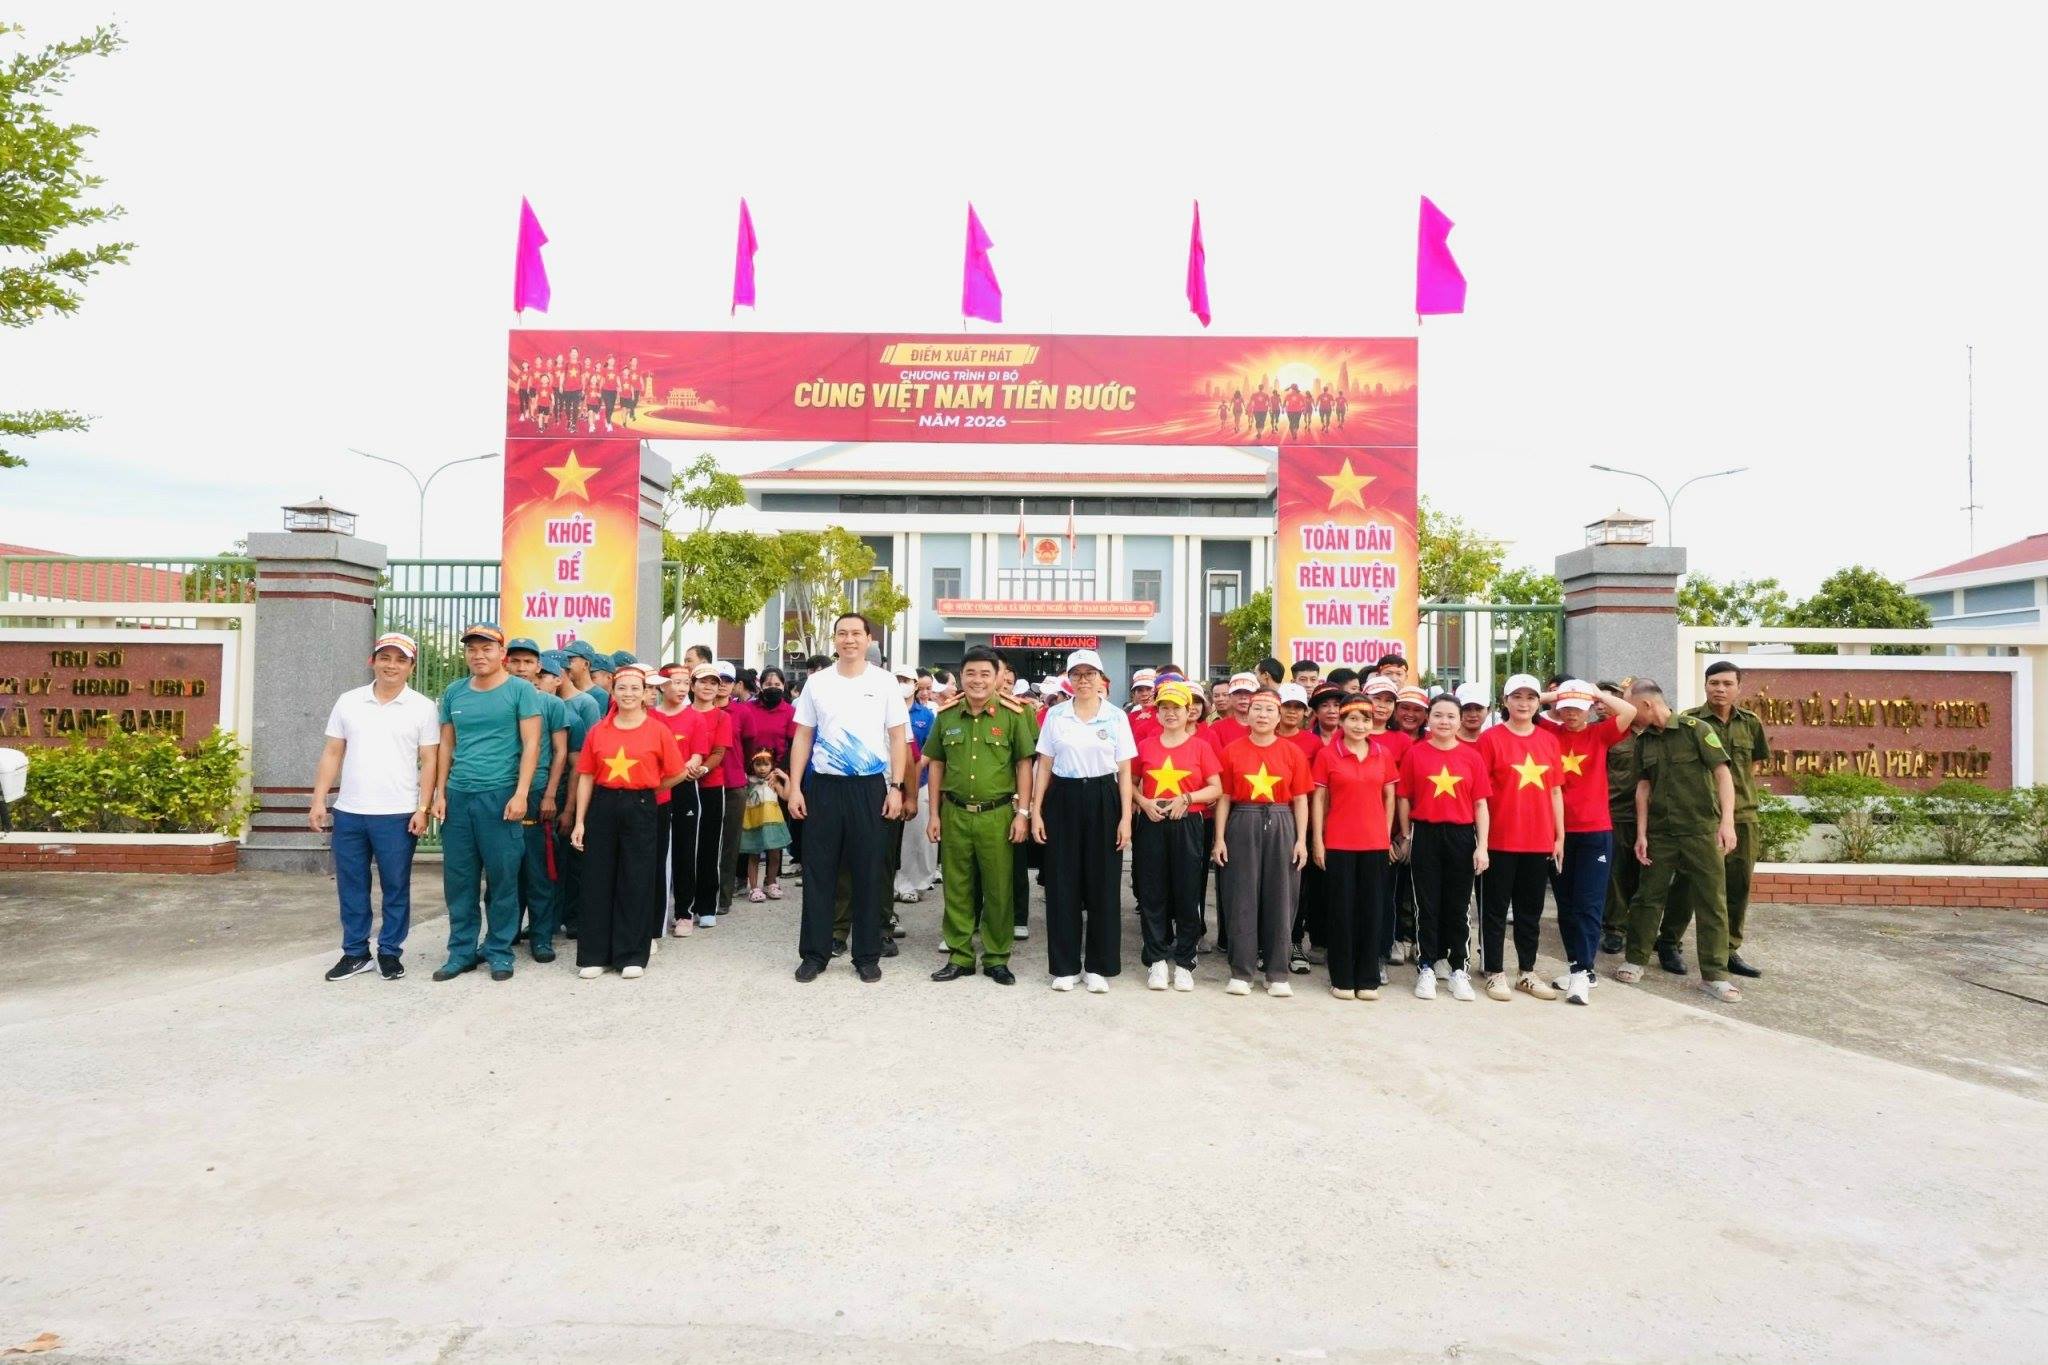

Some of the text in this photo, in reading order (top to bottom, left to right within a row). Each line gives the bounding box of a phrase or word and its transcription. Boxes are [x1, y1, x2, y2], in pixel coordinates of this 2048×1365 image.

[911, 344, 1012, 362] ĐIỂM XUẤT PHÁT
[900, 369, 1019, 382] CHƯƠNG TRÌNH ĐI BỘ
[794, 378, 1136, 412] CÙNG VIỆT NAM TIẾN BƯỚC
[919, 413, 1007, 428] NĂM 2026
[548, 515, 593, 544] KHỎE
[1303, 524, 1391, 550] TOÀN DÂN
[558, 551, 582, 581] ĐỂ
[1300, 561, 1395, 593] RÈN LUYỆN
[526, 591, 611, 623] XÂY DỰNG
[1306, 595, 1390, 625] THÂN THỂ
[1027, 637, 1051, 647] NAM
[1054, 637, 1095, 647] QUANG
[1293, 639, 1402, 663] THEO GƯƠNG
[52, 649, 90, 671] TRỤ
[41, 706, 109, 738] TAM
[1933, 699, 1991, 728] THEO
